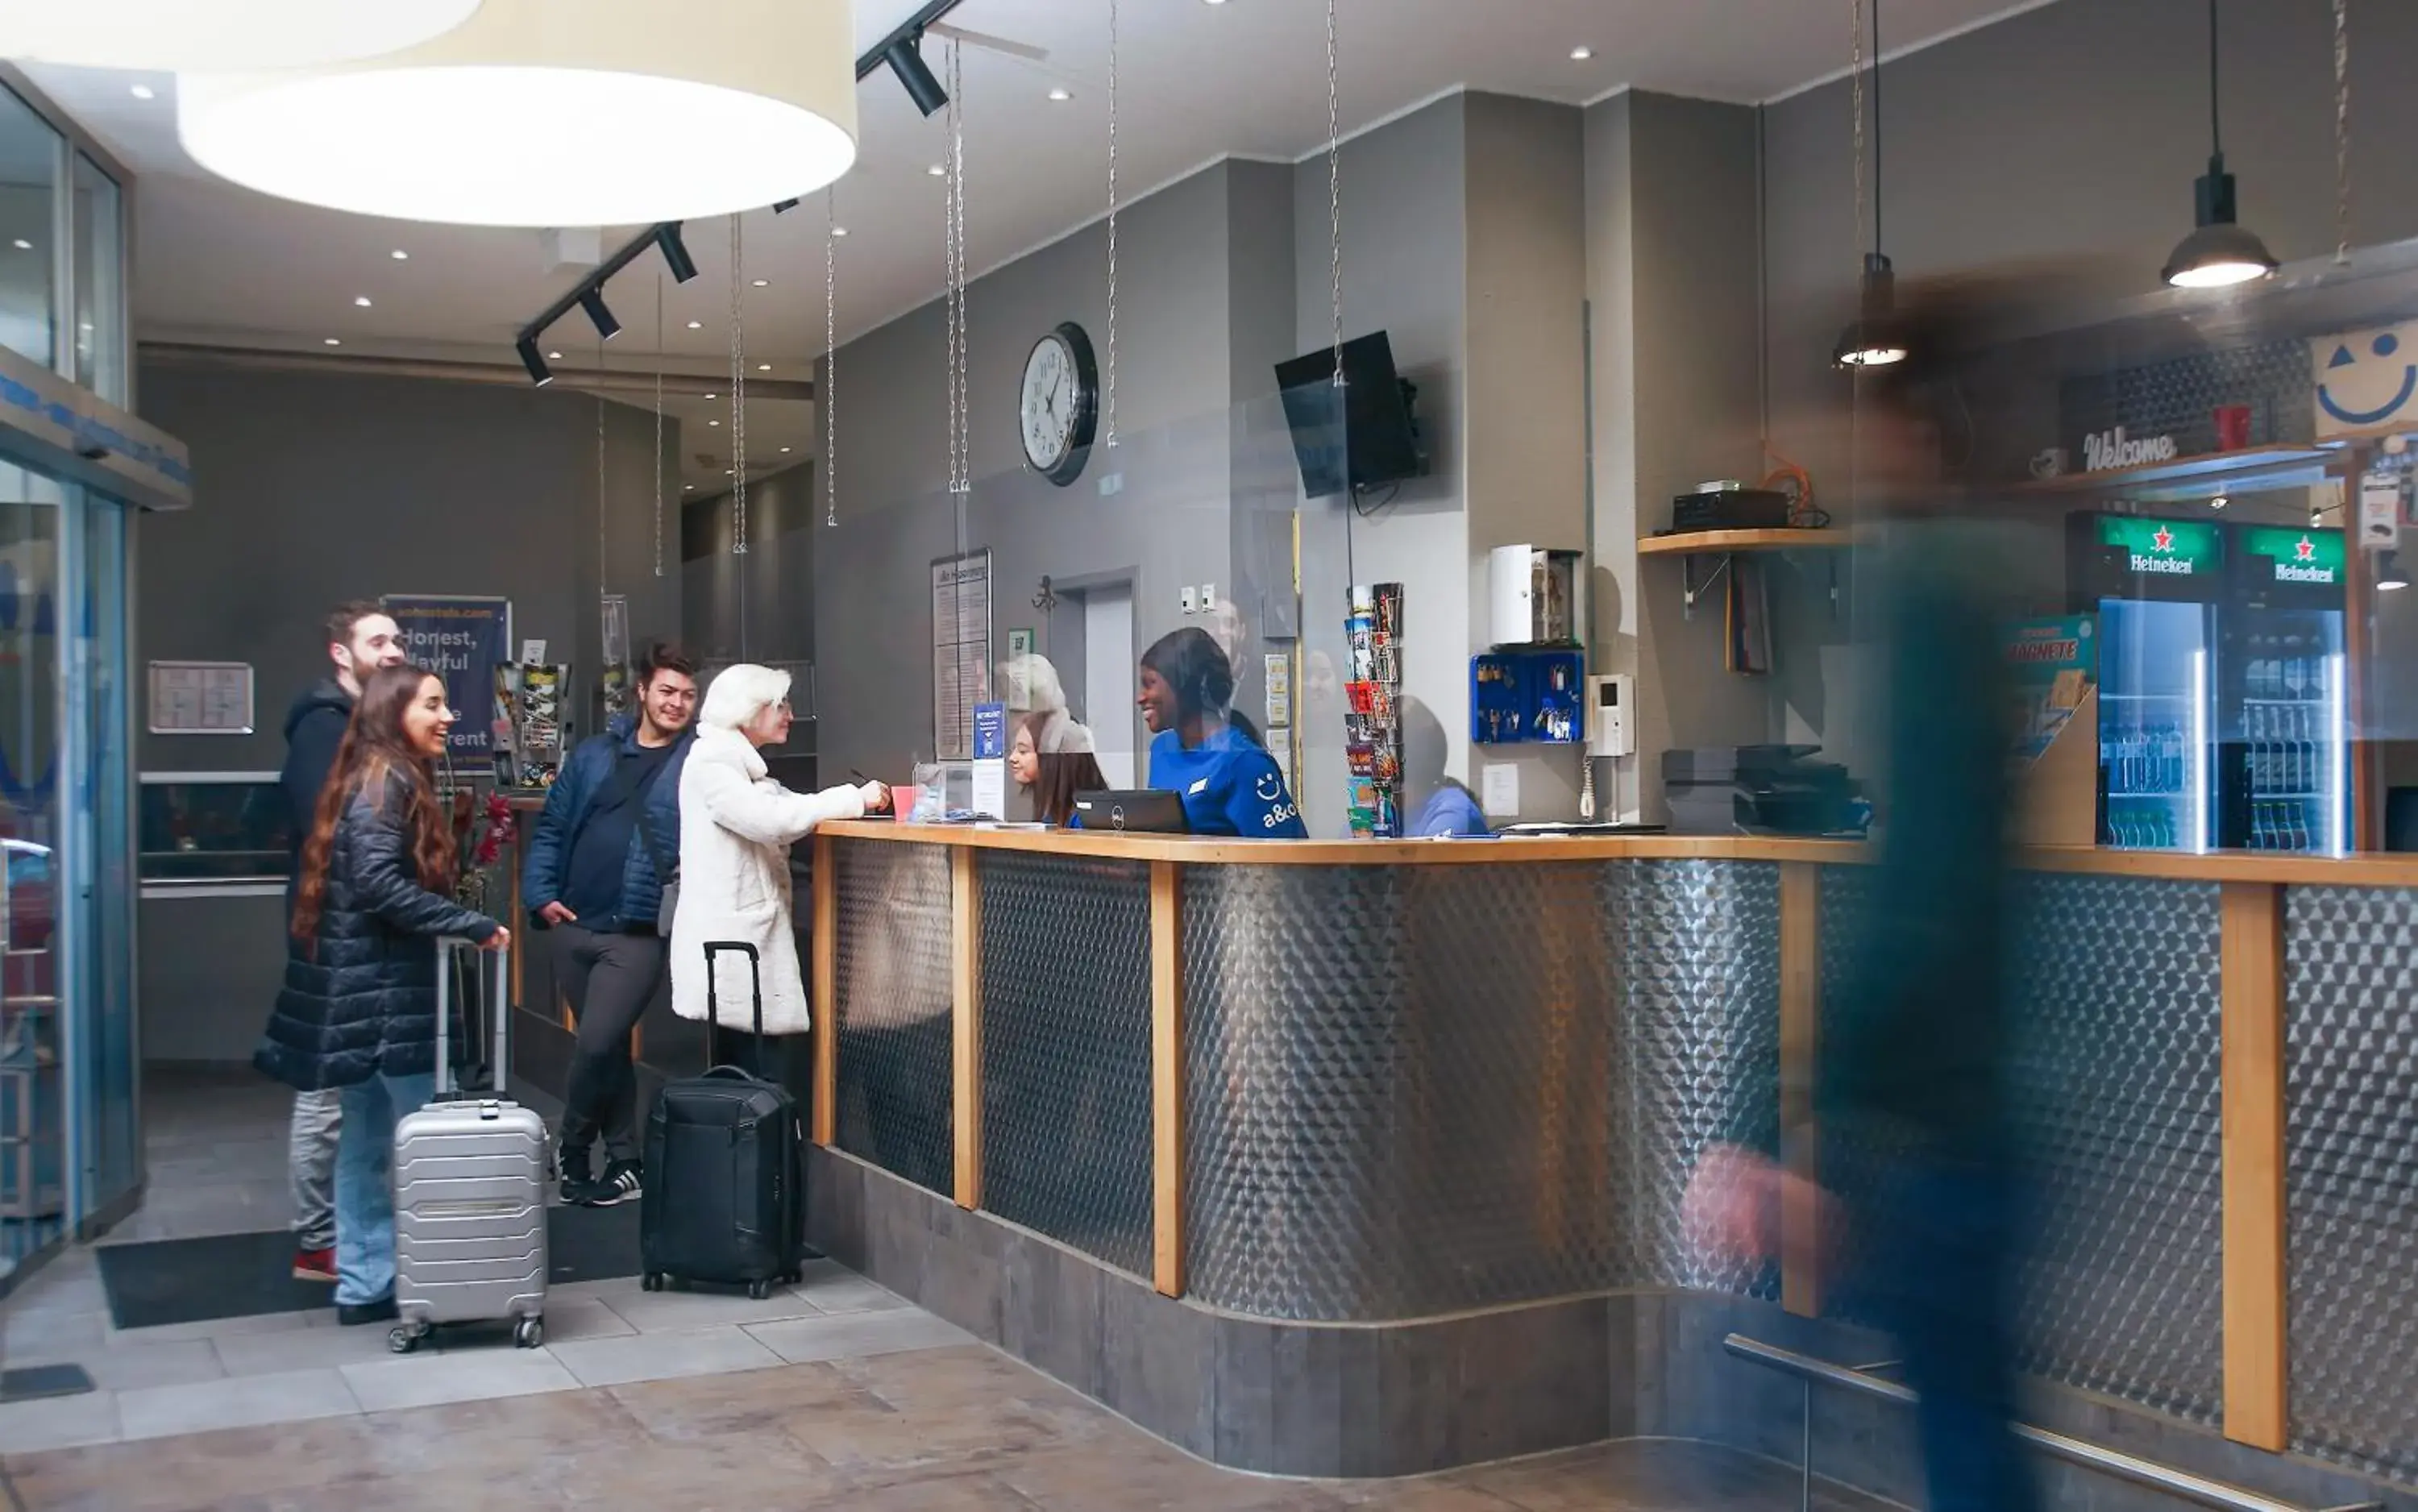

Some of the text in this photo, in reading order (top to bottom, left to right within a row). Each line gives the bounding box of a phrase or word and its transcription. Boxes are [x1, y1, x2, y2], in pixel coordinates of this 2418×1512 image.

[2084, 426, 2178, 473] Welcome
[2130, 555, 2193, 575] Heineken
[2275, 563, 2334, 583] Heineken
[402, 629, 477, 650] Honest,
[409, 649, 468, 673] layful
[1263, 803, 1297, 829] a&o
